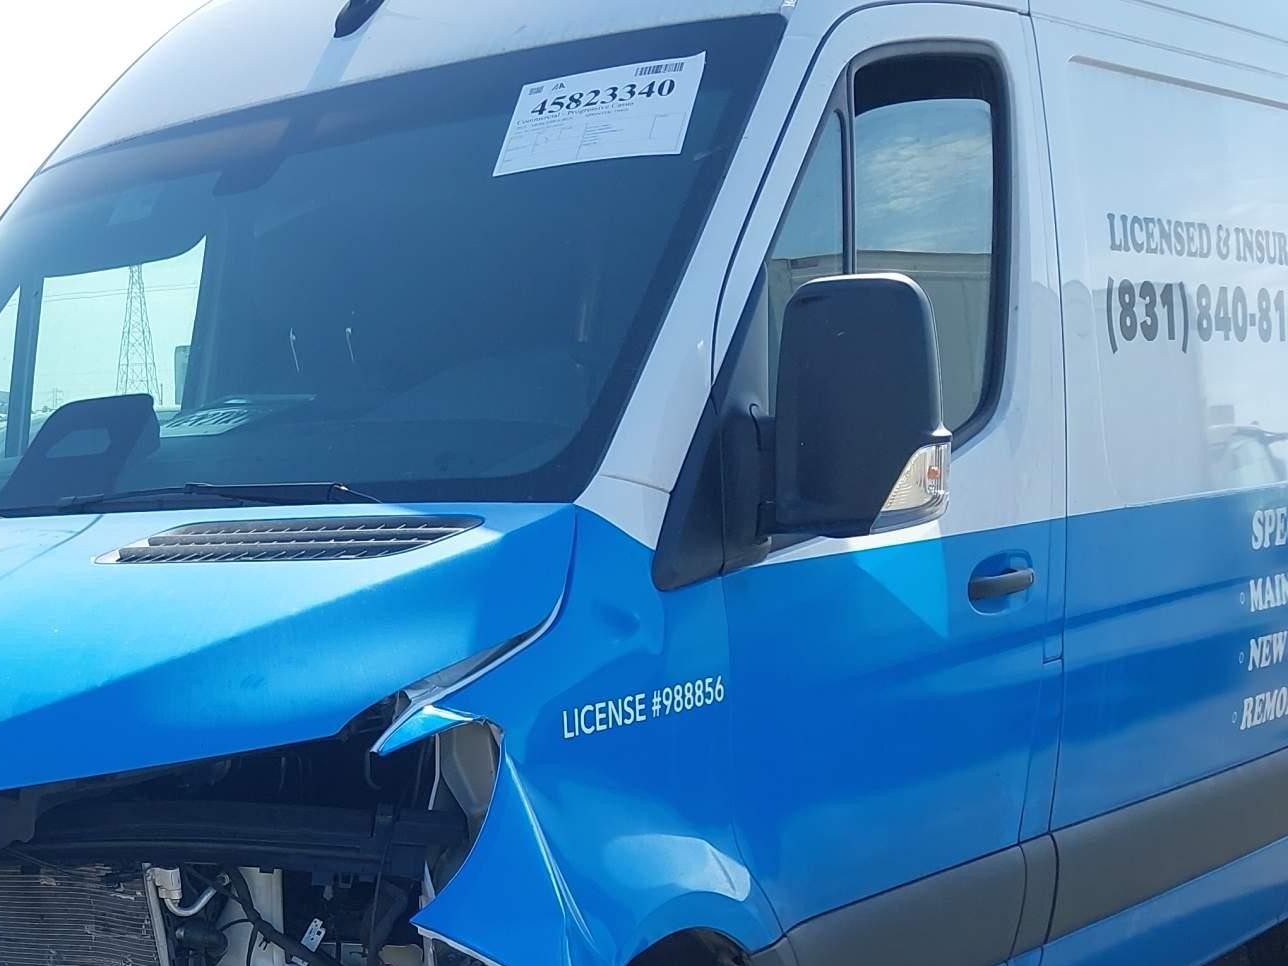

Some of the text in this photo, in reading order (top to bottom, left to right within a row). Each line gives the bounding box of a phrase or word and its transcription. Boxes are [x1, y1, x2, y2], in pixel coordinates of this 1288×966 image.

[530, 78, 675, 116] 45823340
[1107, 213, 1288, 266] LICENSED & INSUR
[1106, 276, 1286, 354] (831) 840-81
[1251, 507, 1288, 550] SPE
[1248, 631, 1288, 671] NEW
[562, 675, 724, 739] LICENSE #988856
[1240, 687, 1288, 730] REMO
